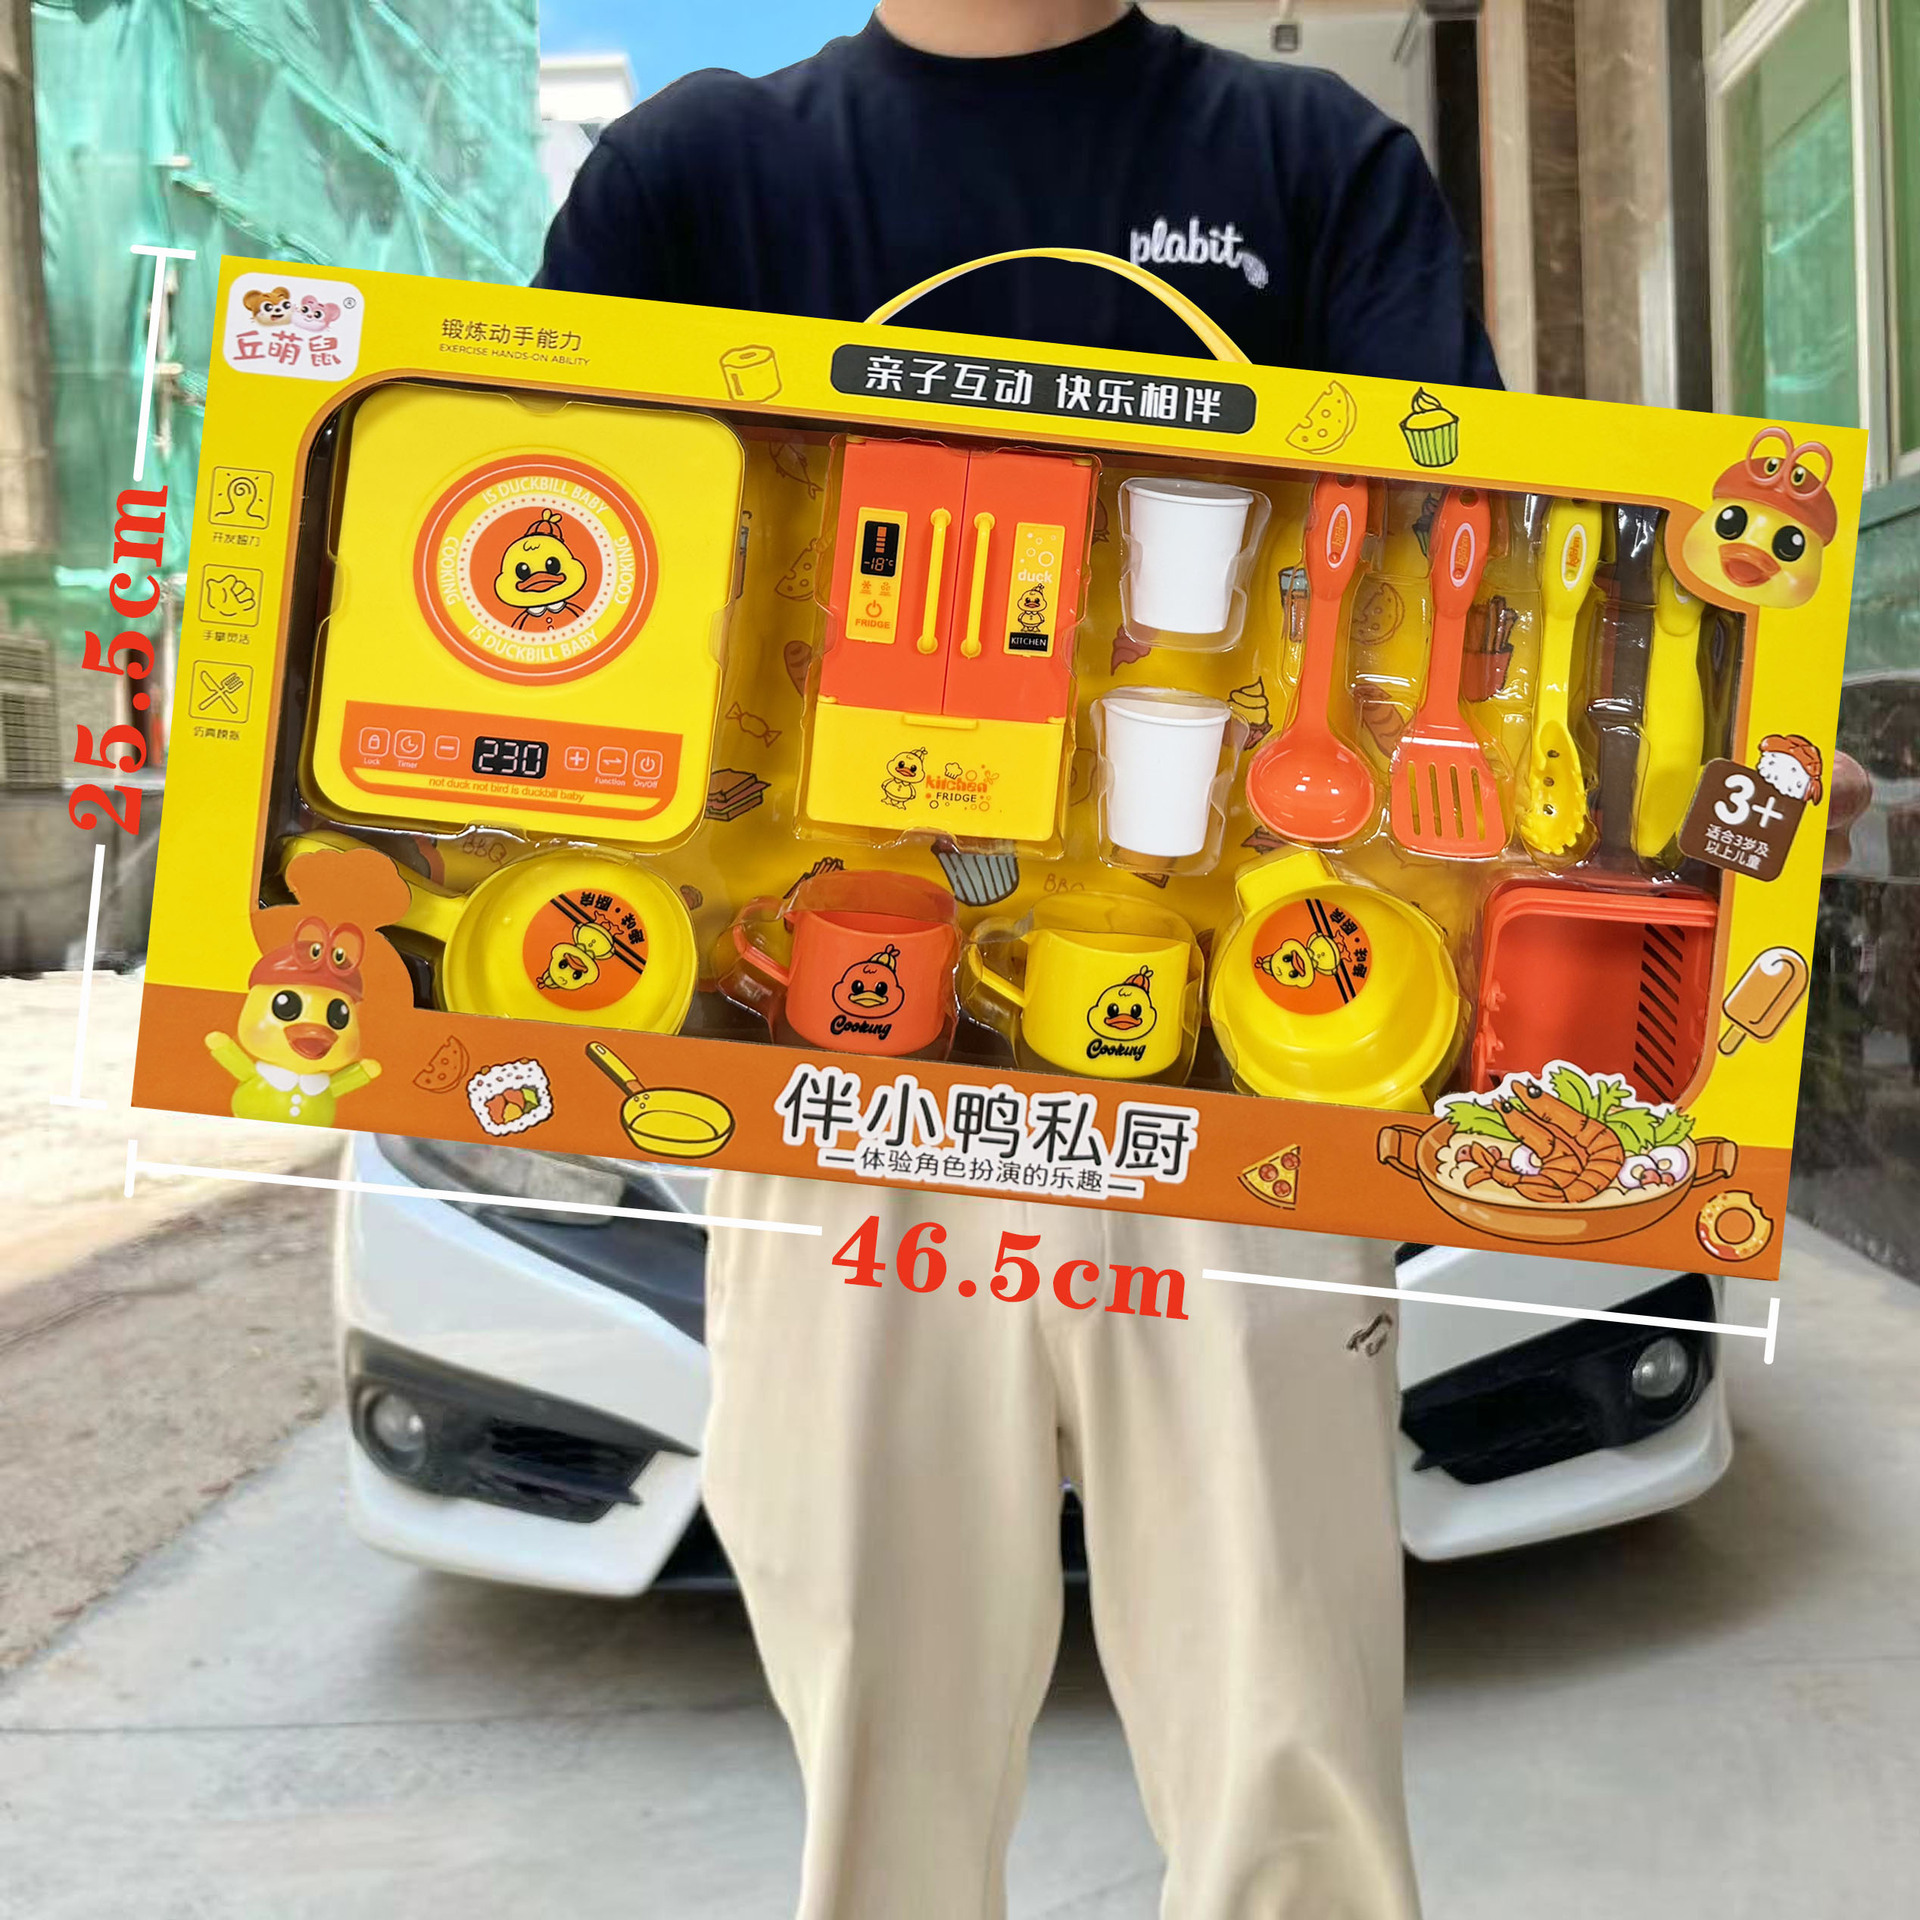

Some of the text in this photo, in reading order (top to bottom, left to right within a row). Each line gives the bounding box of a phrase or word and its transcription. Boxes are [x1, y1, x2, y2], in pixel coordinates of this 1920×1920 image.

[441, 318, 582, 352] 锻炼动手能力
[233, 330, 342, 367] 丘萌鼠
[439, 343, 591, 366] EXERCISE HANDS-ON ABILITY
[865, 355, 1221, 424] 亲子互动 快乐相伴
[482, 477, 609, 514] IS DUCKBILL BABY
[440, 536, 459, 606] COOKING
[614, 535, 635, 605] COOKING
[1018, 569, 1053, 583] duck
[855, 618, 891, 629] FRIDGE
[468, 624, 598, 661] IS DUCKBILL BABY
[1011, 637, 1047, 647] KITCHEN
[363, 757, 381, 765] Lock
[398, 760, 418, 769] Timer
[478, 739, 543, 775] 230
[428, 777, 585, 803] not duck not bird is duckbill baby
[595, 777, 626, 786] Function
[633, 779, 659, 788] On/Off
[925, 775, 987, 793] kitchen
[936, 792, 977, 802] FRIDGE
[1714, 774, 1784, 828] 3+
[1705, 824, 1769, 857] 适合3岁及
[1704, 841, 1761, 870] 以上儿童
[830, 1014, 892, 1040] Cooking
[1086, 1038, 1146, 1061] Cooking
[783, 1072, 1191, 1175] 伴小鸭私厨
